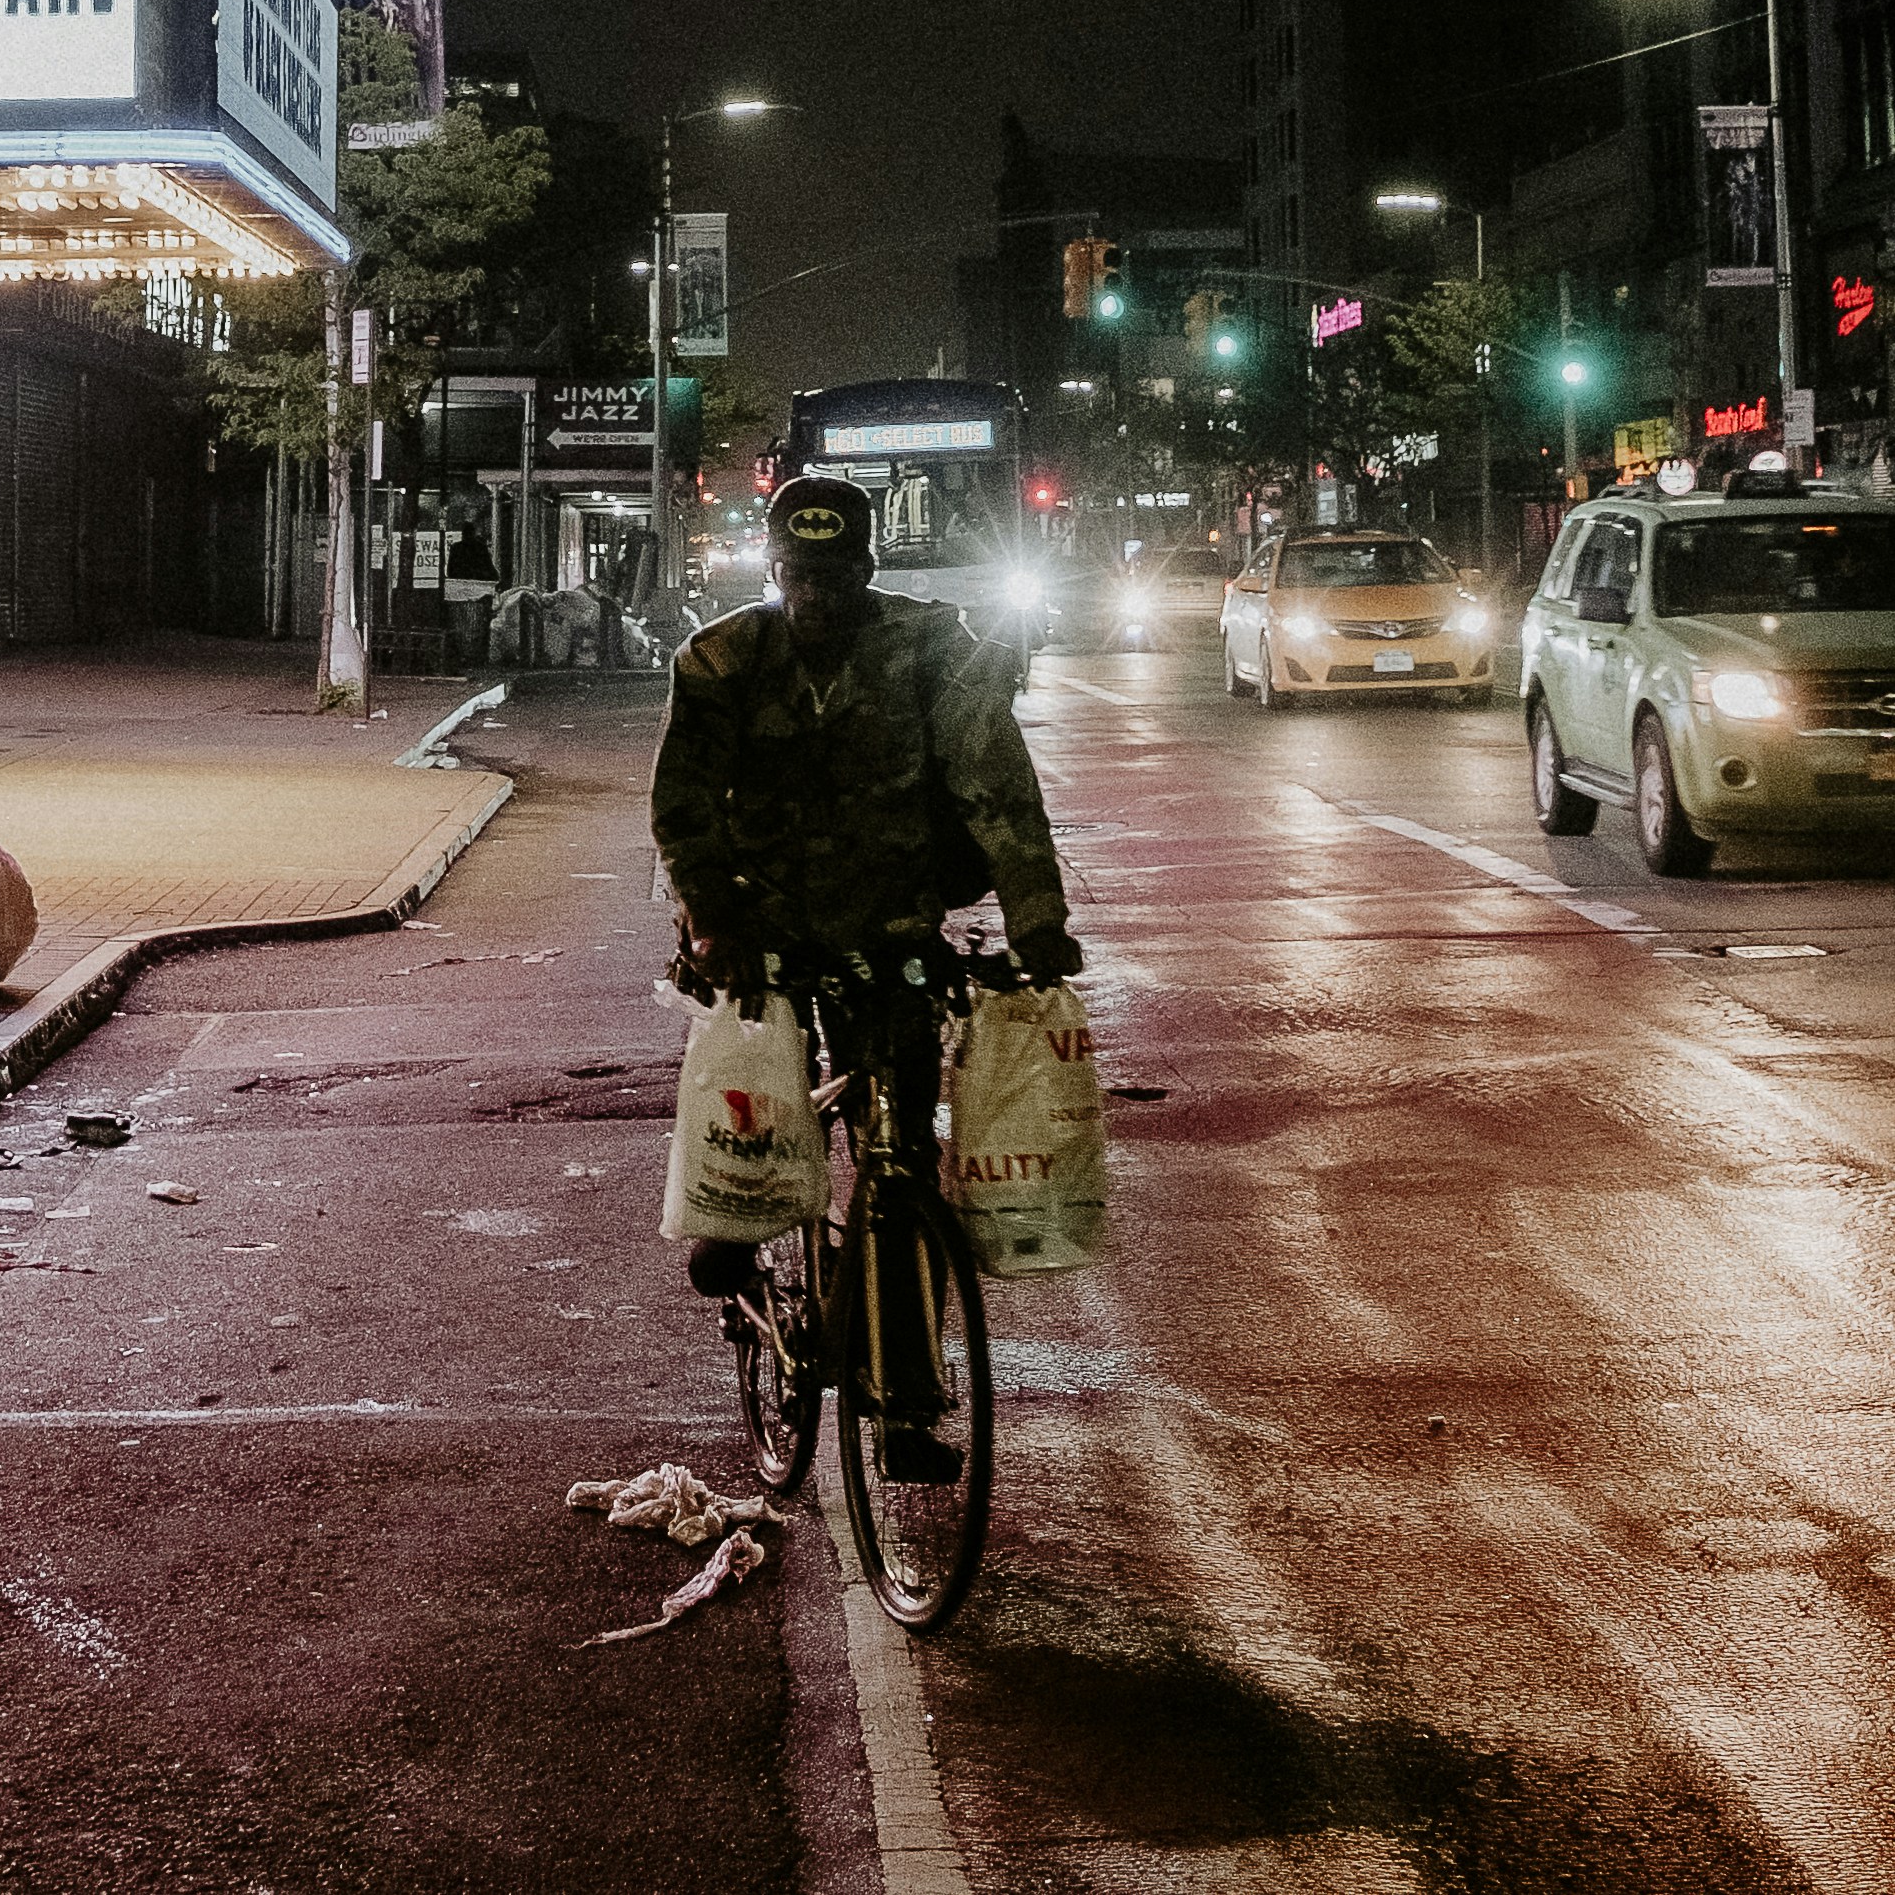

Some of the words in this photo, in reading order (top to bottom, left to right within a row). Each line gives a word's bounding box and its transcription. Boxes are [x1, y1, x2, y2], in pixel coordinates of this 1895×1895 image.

[553, 386, 649, 402] JIMMY
[561, 405, 639, 421] JAZZ
[608, 434, 640, 443] OPEN
[950, 425, 983, 444] BUS
